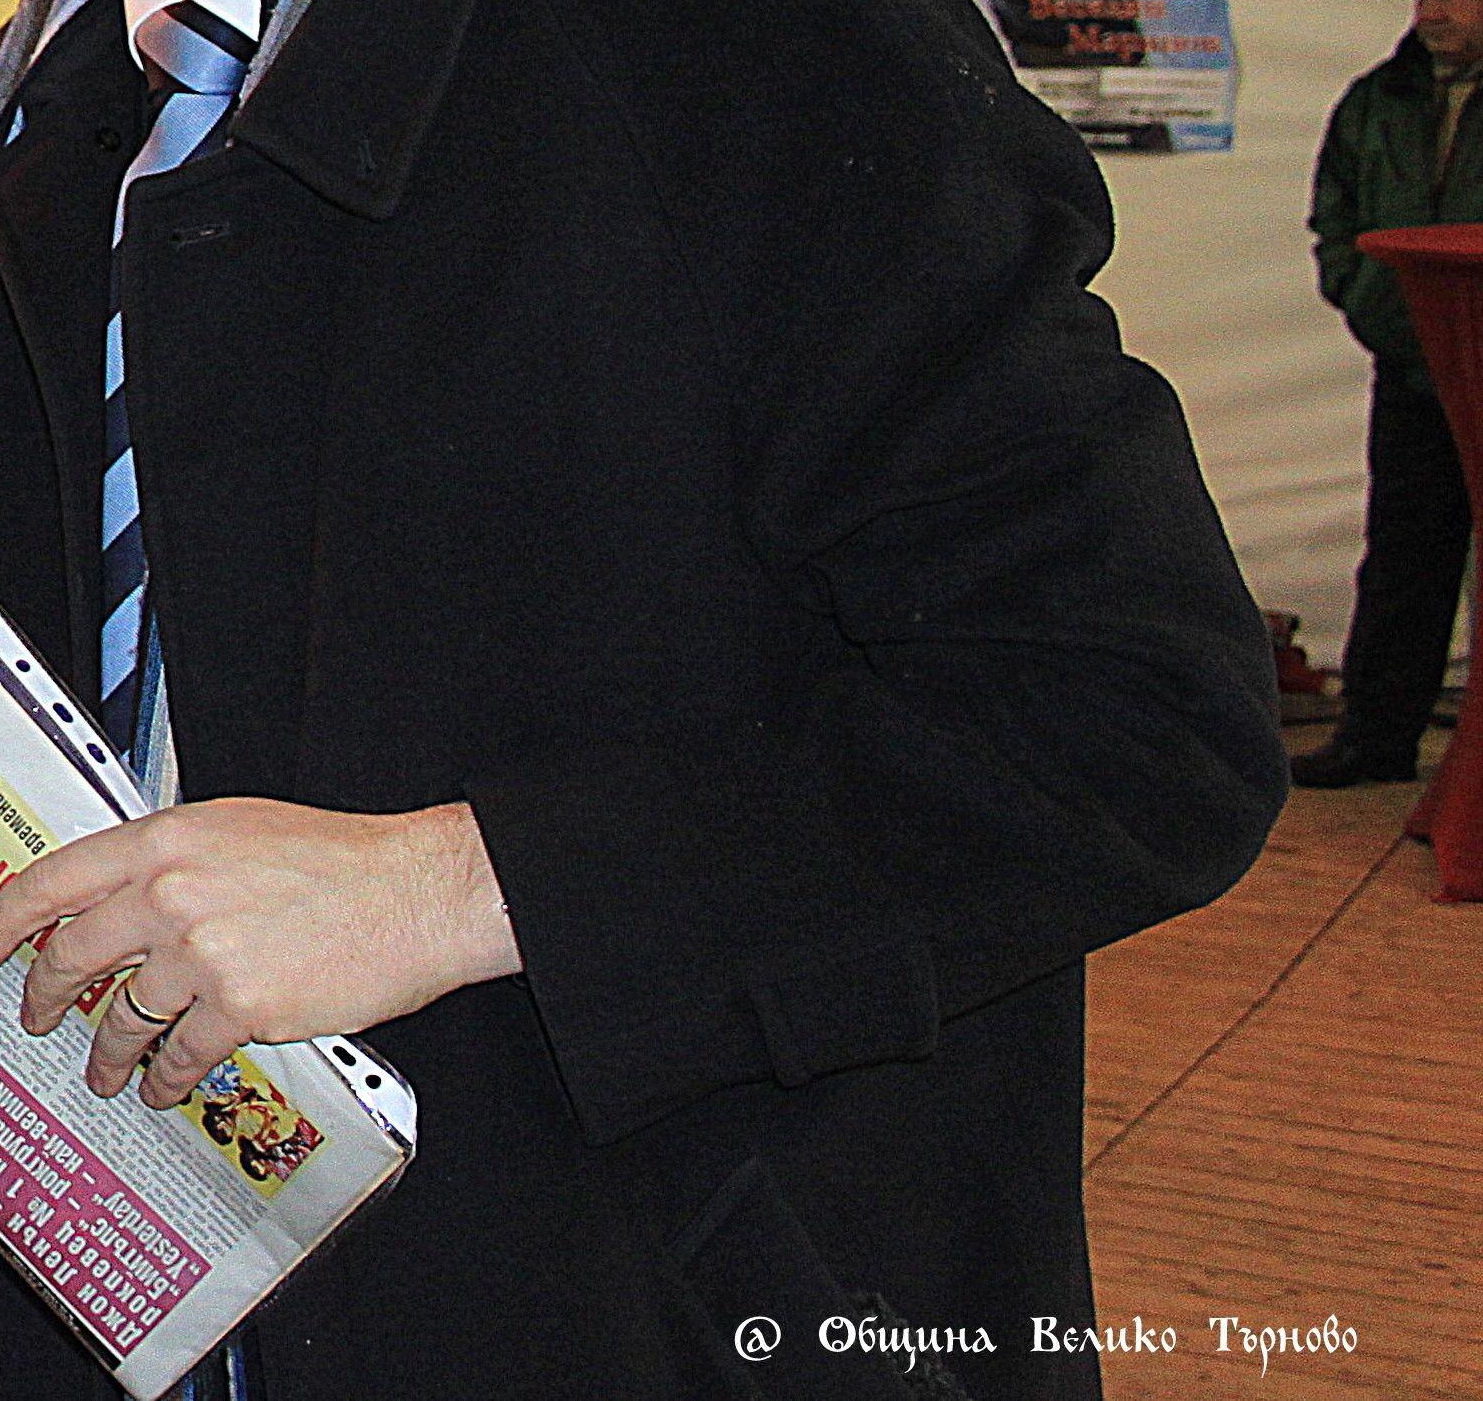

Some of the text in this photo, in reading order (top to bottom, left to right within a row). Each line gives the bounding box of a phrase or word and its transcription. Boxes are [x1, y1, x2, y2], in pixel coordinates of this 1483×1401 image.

[5, 1177, 24, 1198] 1
[26, 1195, 55, 1228] №
[6, 1212, 78, 1286] Ленън
[90, 1190, 200, 1280] „Yesterday“
[53, 1219, 162, 1326] рокпевец
[76, 1282, 143, 1348] Джон
